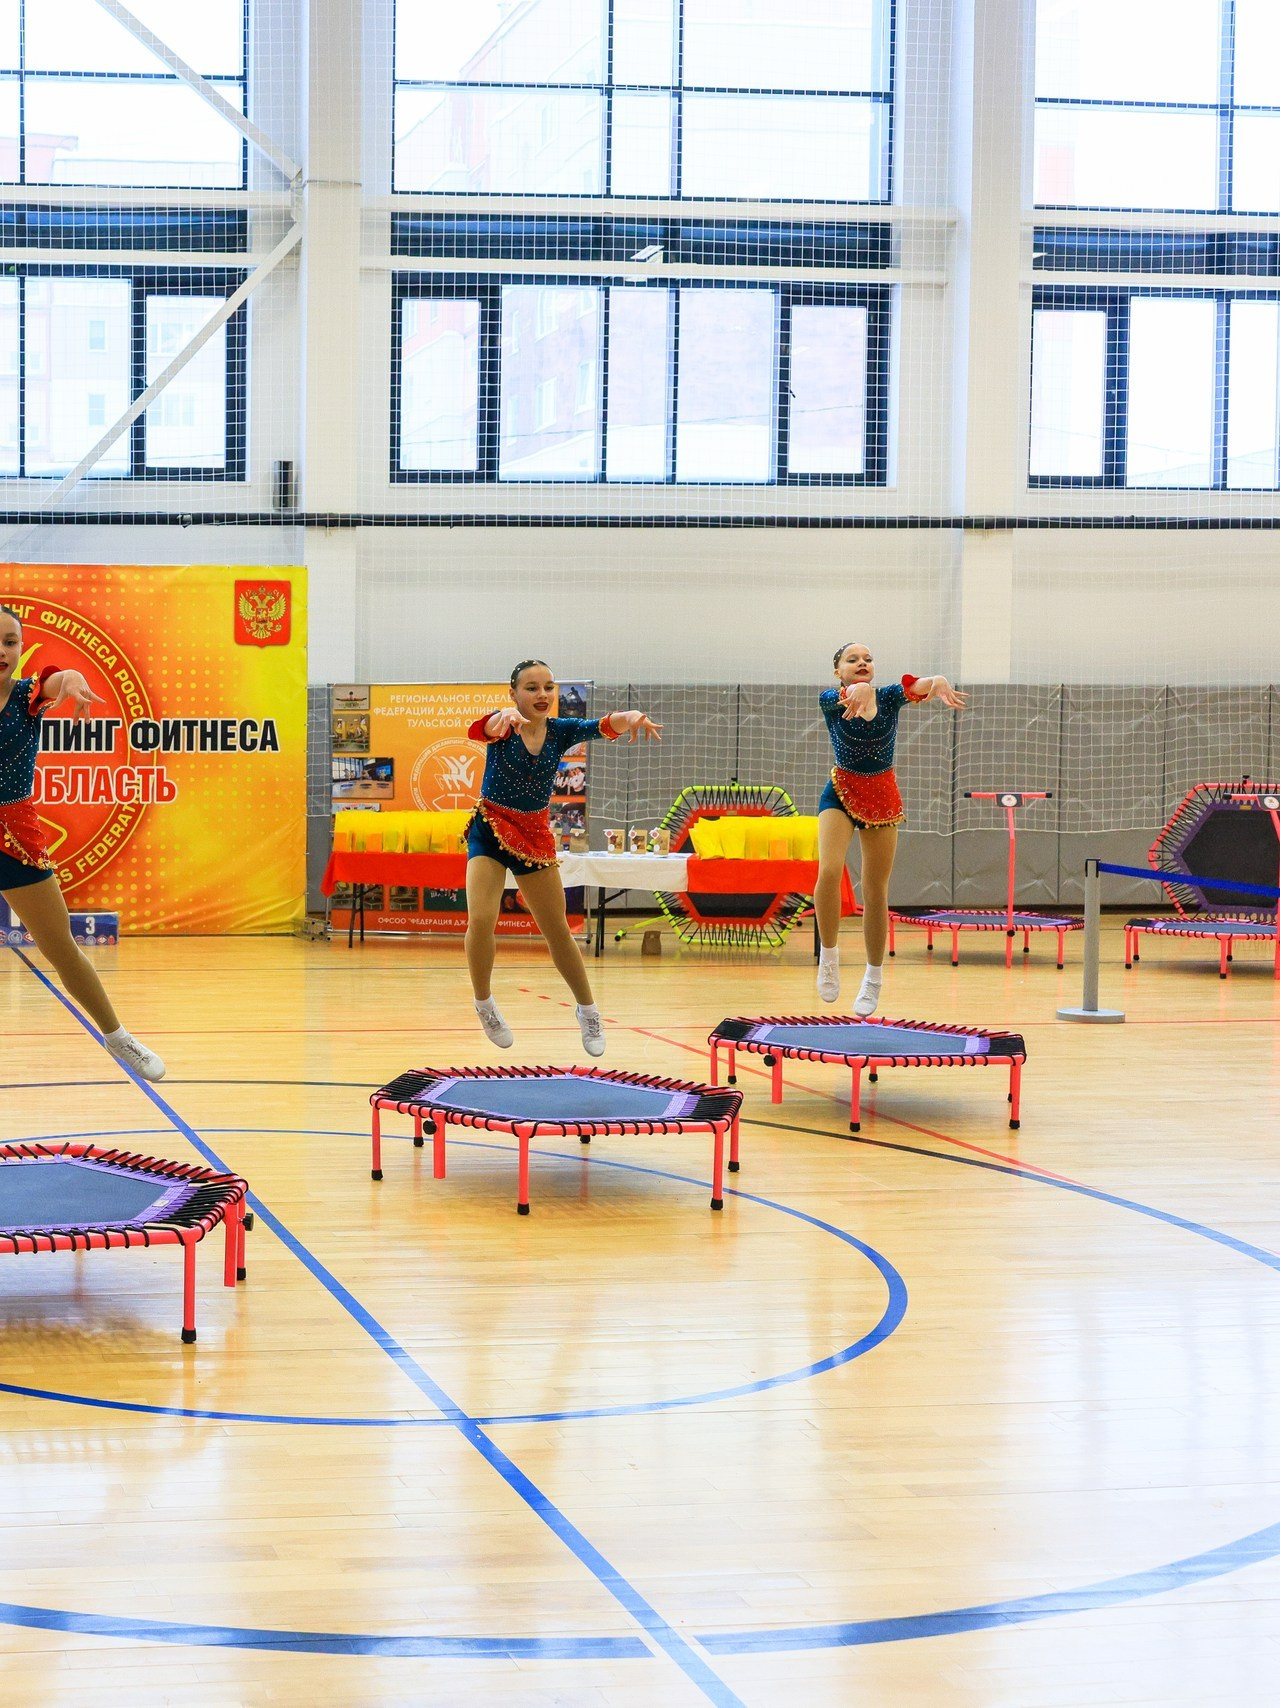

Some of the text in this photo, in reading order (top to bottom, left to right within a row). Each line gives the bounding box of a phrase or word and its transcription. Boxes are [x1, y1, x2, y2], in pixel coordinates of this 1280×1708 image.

[40, 610, 118, 670] ФИТНЕСА
[114, 668, 146, 722] РОСС
[389, 694, 513, 704] РЕГИОНАЛЬНОЕ ОТДЕЛЕ
[373, 706, 435, 717] ФЕДЕРАЦИИ
[407, 717, 462, 728] ТУЛЬСКОЙ
[129, 717, 280, 753] ФИТНЕСА
[75, 797, 137, 874] FEDERAT
[85, 916, 96, 935] 3
[377, 917, 407, 925] ОФСОО
[408, 917, 453, 927] "ФЕДЕРАЦИЯ
[497, 920, 535, 928] ФИТНЕСА"
